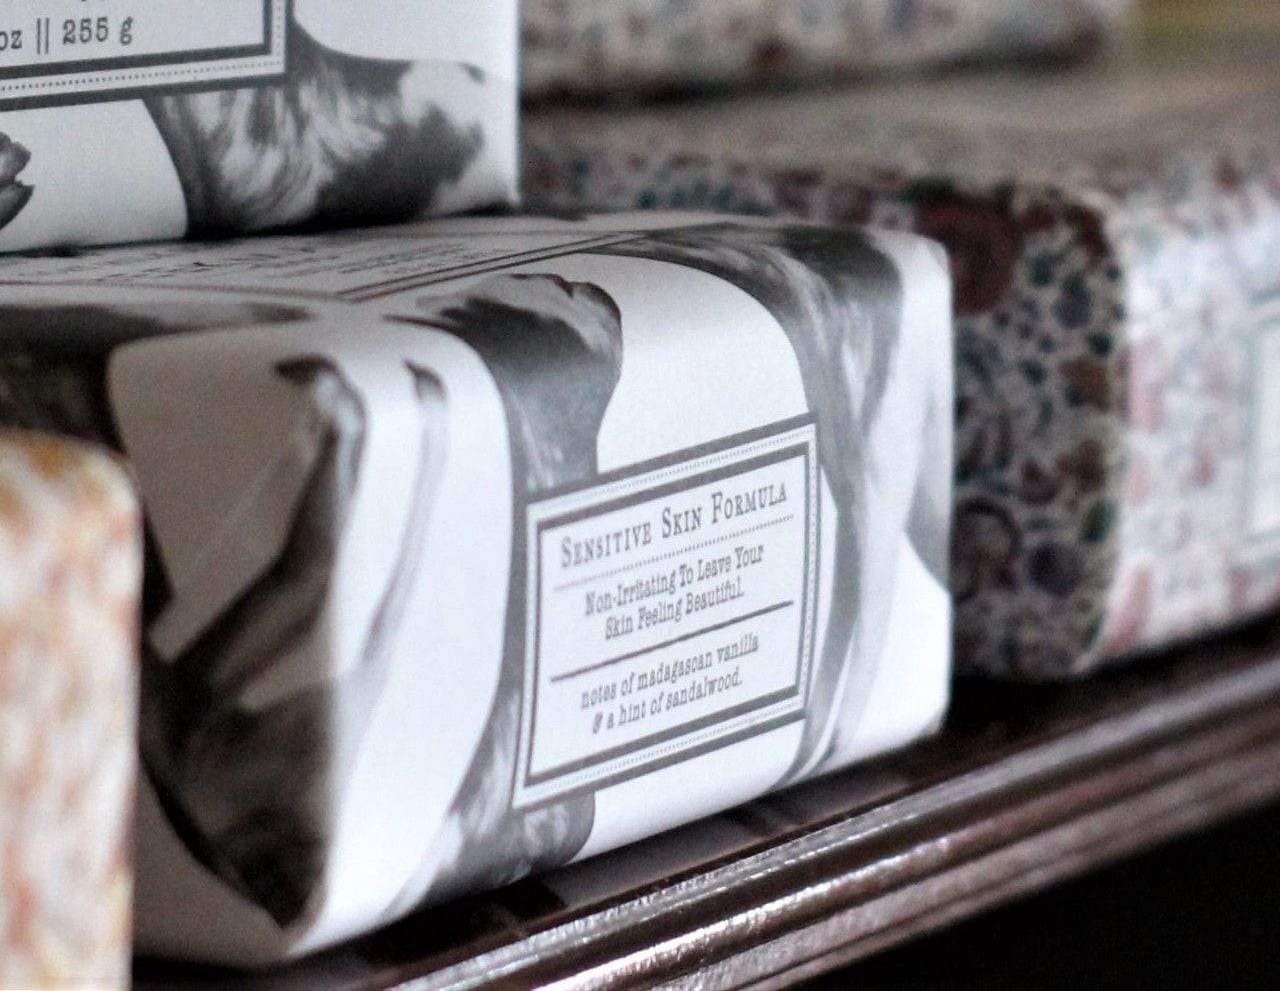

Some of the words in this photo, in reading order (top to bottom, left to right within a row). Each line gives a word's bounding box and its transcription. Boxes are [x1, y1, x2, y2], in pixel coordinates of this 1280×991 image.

[63, 17, 109, 45] 255
[120, 16, 134, 45] g
[585, 573, 676, 617] Non-Irritating
[679, 563, 694, 585] To
[697, 556, 731, 583] Leave
[734, 544, 763, 569] Your
[605, 612, 633, 640] Skin
[637, 598, 682, 632] Feeling
[685, 577, 744, 616] Beautiful.
[581, 680, 616, 710] notes
[620, 671, 635, 696] of
[638, 646, 712, 688] madagascan
[717, 632, 759, 661] vanilla
[593, 713, 602, 734] &
[607, 711, 614, 730] a
[619, 701, 645, 726] hint
[650, 690, 663, 715] of
[666, 667, 742, 711] sandalwood.
